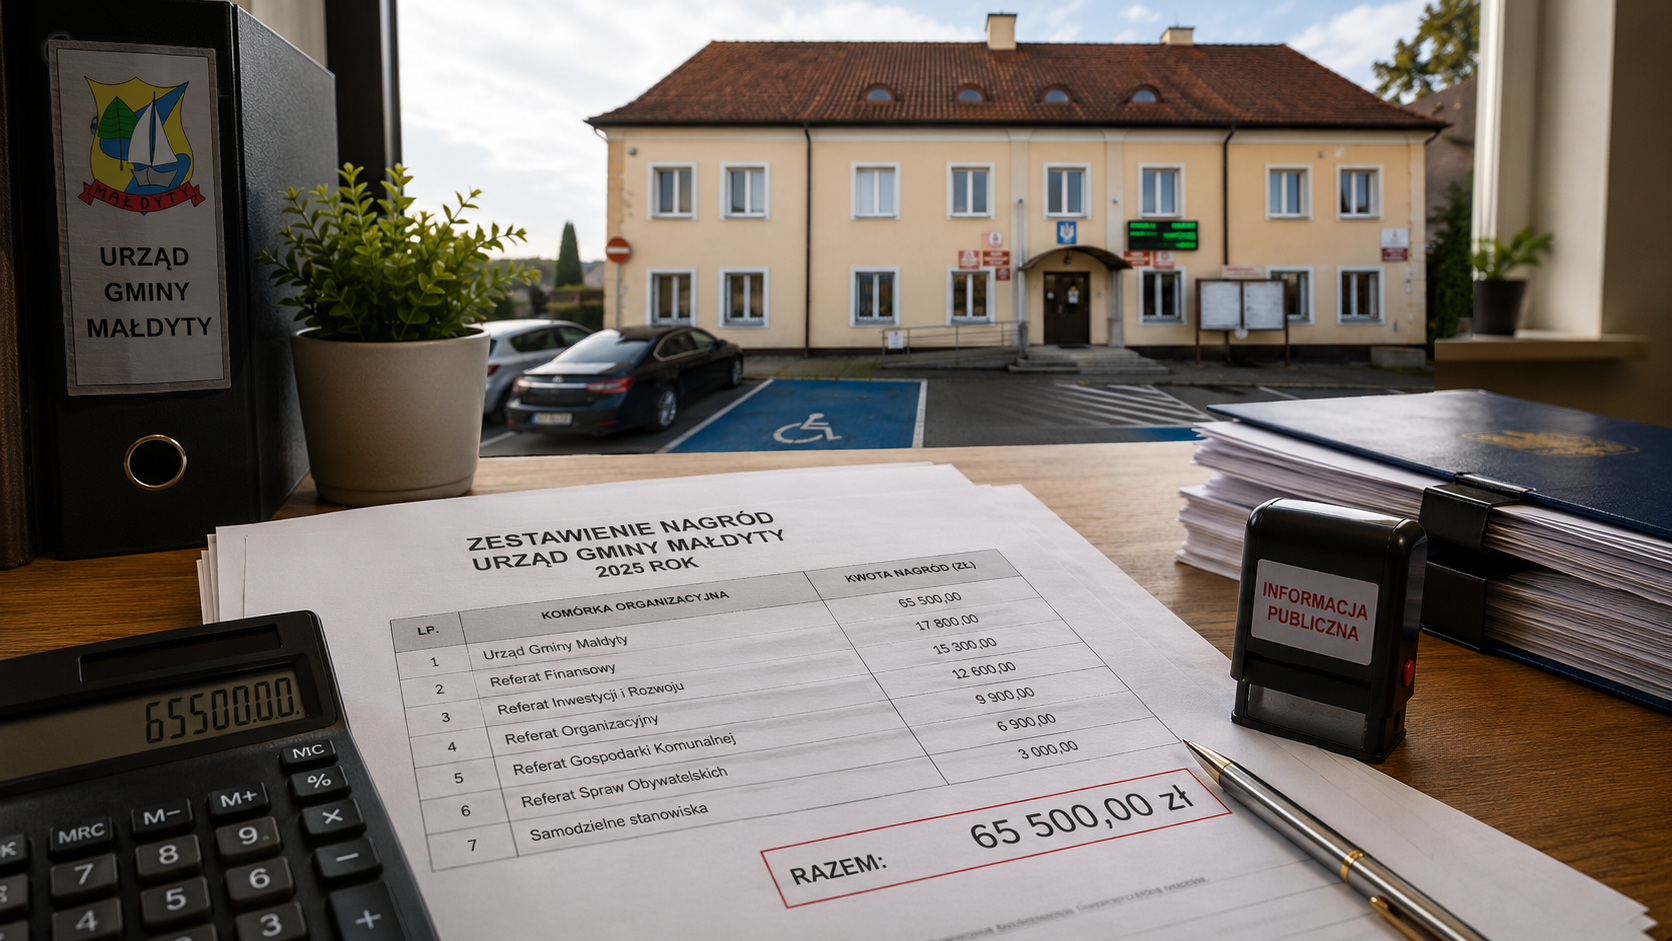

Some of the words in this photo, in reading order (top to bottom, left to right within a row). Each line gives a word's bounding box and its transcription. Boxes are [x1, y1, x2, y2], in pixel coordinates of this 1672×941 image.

[94, 184, 190, 210] MAŁDYTY
[100, 247, 189, 271] URZĄD
[104, 282, 190, 302] GMINY
[87, 317, 212, 339] MAŁDYTY
[466, 522, 655, 552] ZESTAWIENIE
[660, 510, 775, 534] NAGRÓD
[472, 550, 568, 571] URZĄD
[576, 541, 658, 561] GMINY
[666, 528, 786, 552] MAŁDYTY
[595, 563, 645, 578] 2025
[649, 556, 700, 573] ROK
[845, 571, 893, 583] KWOTA
[893, 563, 950, 577] NAGRÓD
[951, 560, 977, 572] (ZŁ)
[540, 604, 613, 620] KOMÓRKA
[615, 590, 730, 612] ORGANIZACYJNA
[898, 597, 916, 609] 65
[918, 591, 963, 606] 500,00
[1263, 581, 1368, 621] INFORMACJA
[417, 625, 440, 636] LP.
[915, 620, 931, 632] 17
[933, 613, 980, 630] 800,00
[1267, 605, 1359, 642] PUBLICZNA
[483, 646, 525, 661] Urząd
[529, 639, 572, 655] Gminy
[933, 643, 951, 655] 15
[951, 637, 998, 652] 300,00
[430, 657, 440, 667] 1
[951, 668, 971, 680] 12
[971, 661, 1017, 676] 600,00
[489, 672, 542, 688] Referat
[544, 663, 616, 681] Finansowy
[435, 684, 445, 695] 2
[497, 700, 550, 715] Referat
[552, 689, 619, 708] Inwestycji
[620, 688, 626, 698] i
[628, 681, 685, 698] Rozwoju
[975, 694, 987, 705] 9
[987, 686, 1035, 703] 900,00
[441, 712, 451, 723] 3
[997, 720, 1008, 732] 6
[1009, 713, 1057, 730] 900,00
[504, 728, 558, 745] Referat
[561, 713, 659, 737] Organizacyjny
[292, 744, 325, 759] MC
[448, 742, 457, 752] 4
[512, 758, 567, 776] Referat
[570, 744, 652, 767] Gospodarki
[654, 732, 737, 755] Komunalnej
[1018, 748, 1029, 760] 3
[1030, 740, 1079, 757] 000,00
[307, 773, 332, 788] %
[454, 772, 464, 784] 5
[521, 790, 577, 808] Referat
[579, 783, 624, 800] Spraw
[627, 765, 728, 792] Obywatelskich
[220, 790, 258, 808] M+
[461, 804, 471, 817] 6
[969, 819, 1021, 849] 65
[1025, 793, 1154, 838] 500,00
[1158, 784, 1195, 811] zł
[58, 822, 105, 844] MRC
[530, 816, 626, 842] Samodzielne
[630, 802, 709, 826] stanowiska
[238, 826, 258, 845] 9
[467, 839, 477, 852] 7
[159, 845, 179, 865] 8
[73, 863, 94, 886] 7
[249, 868, 270, 889] 6
[789, 853, 888, 886] RAZEM:
[166, 887, 187, 911] 5
[75, 909, 99, 931] 4
[260, 913, 282, 937] 3
